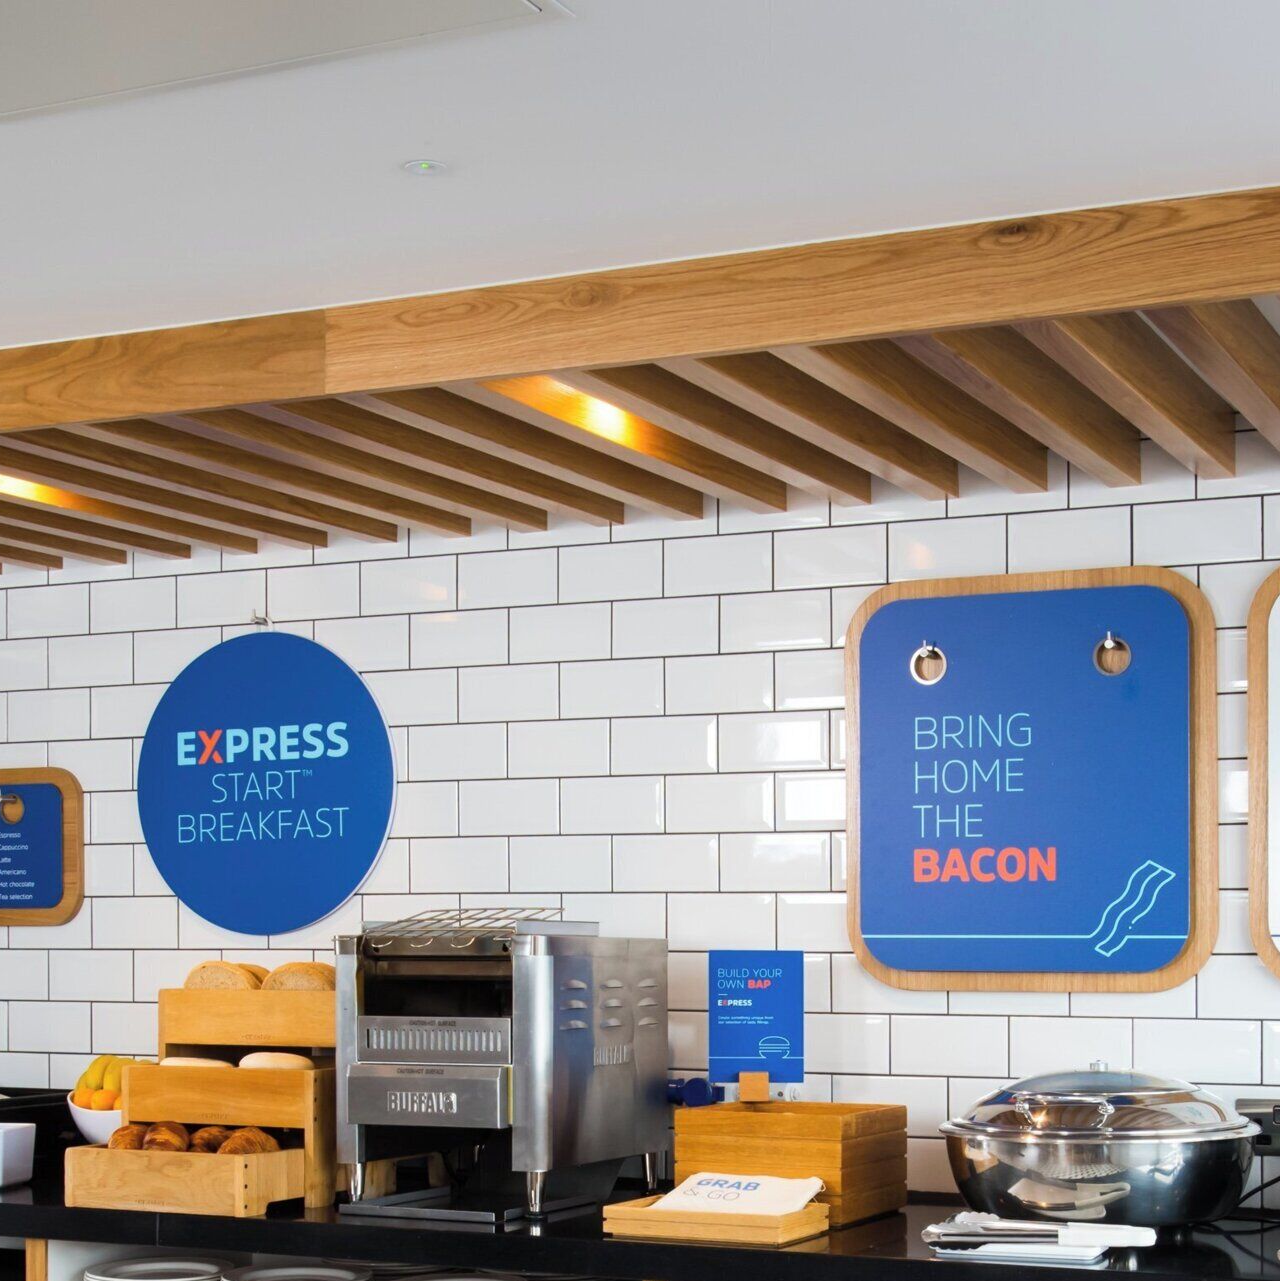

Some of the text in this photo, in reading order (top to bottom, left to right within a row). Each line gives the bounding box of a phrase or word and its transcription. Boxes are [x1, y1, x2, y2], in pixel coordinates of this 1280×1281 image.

[176, 721, 349, 766] EXPRESS
[914, 712, 1032, 751] BRING
[914, 757, 1025, 794] HOME
[177, 806, 350, 844] BREAKFAST
[912, 803, 984, 838] THE
[913, 846, 1057, 883] BACON
[717, 968, 783, 978] BUILD YOUR
[717, 979, 772, 989] OWN BAP
[717, 999, 752, 1007] EXPRESS
[387, 1091, 458, 1114] BUFFALO
[696, 1178, 761, 1191] GRAB
[707, 1189, 740, 1201] GO
